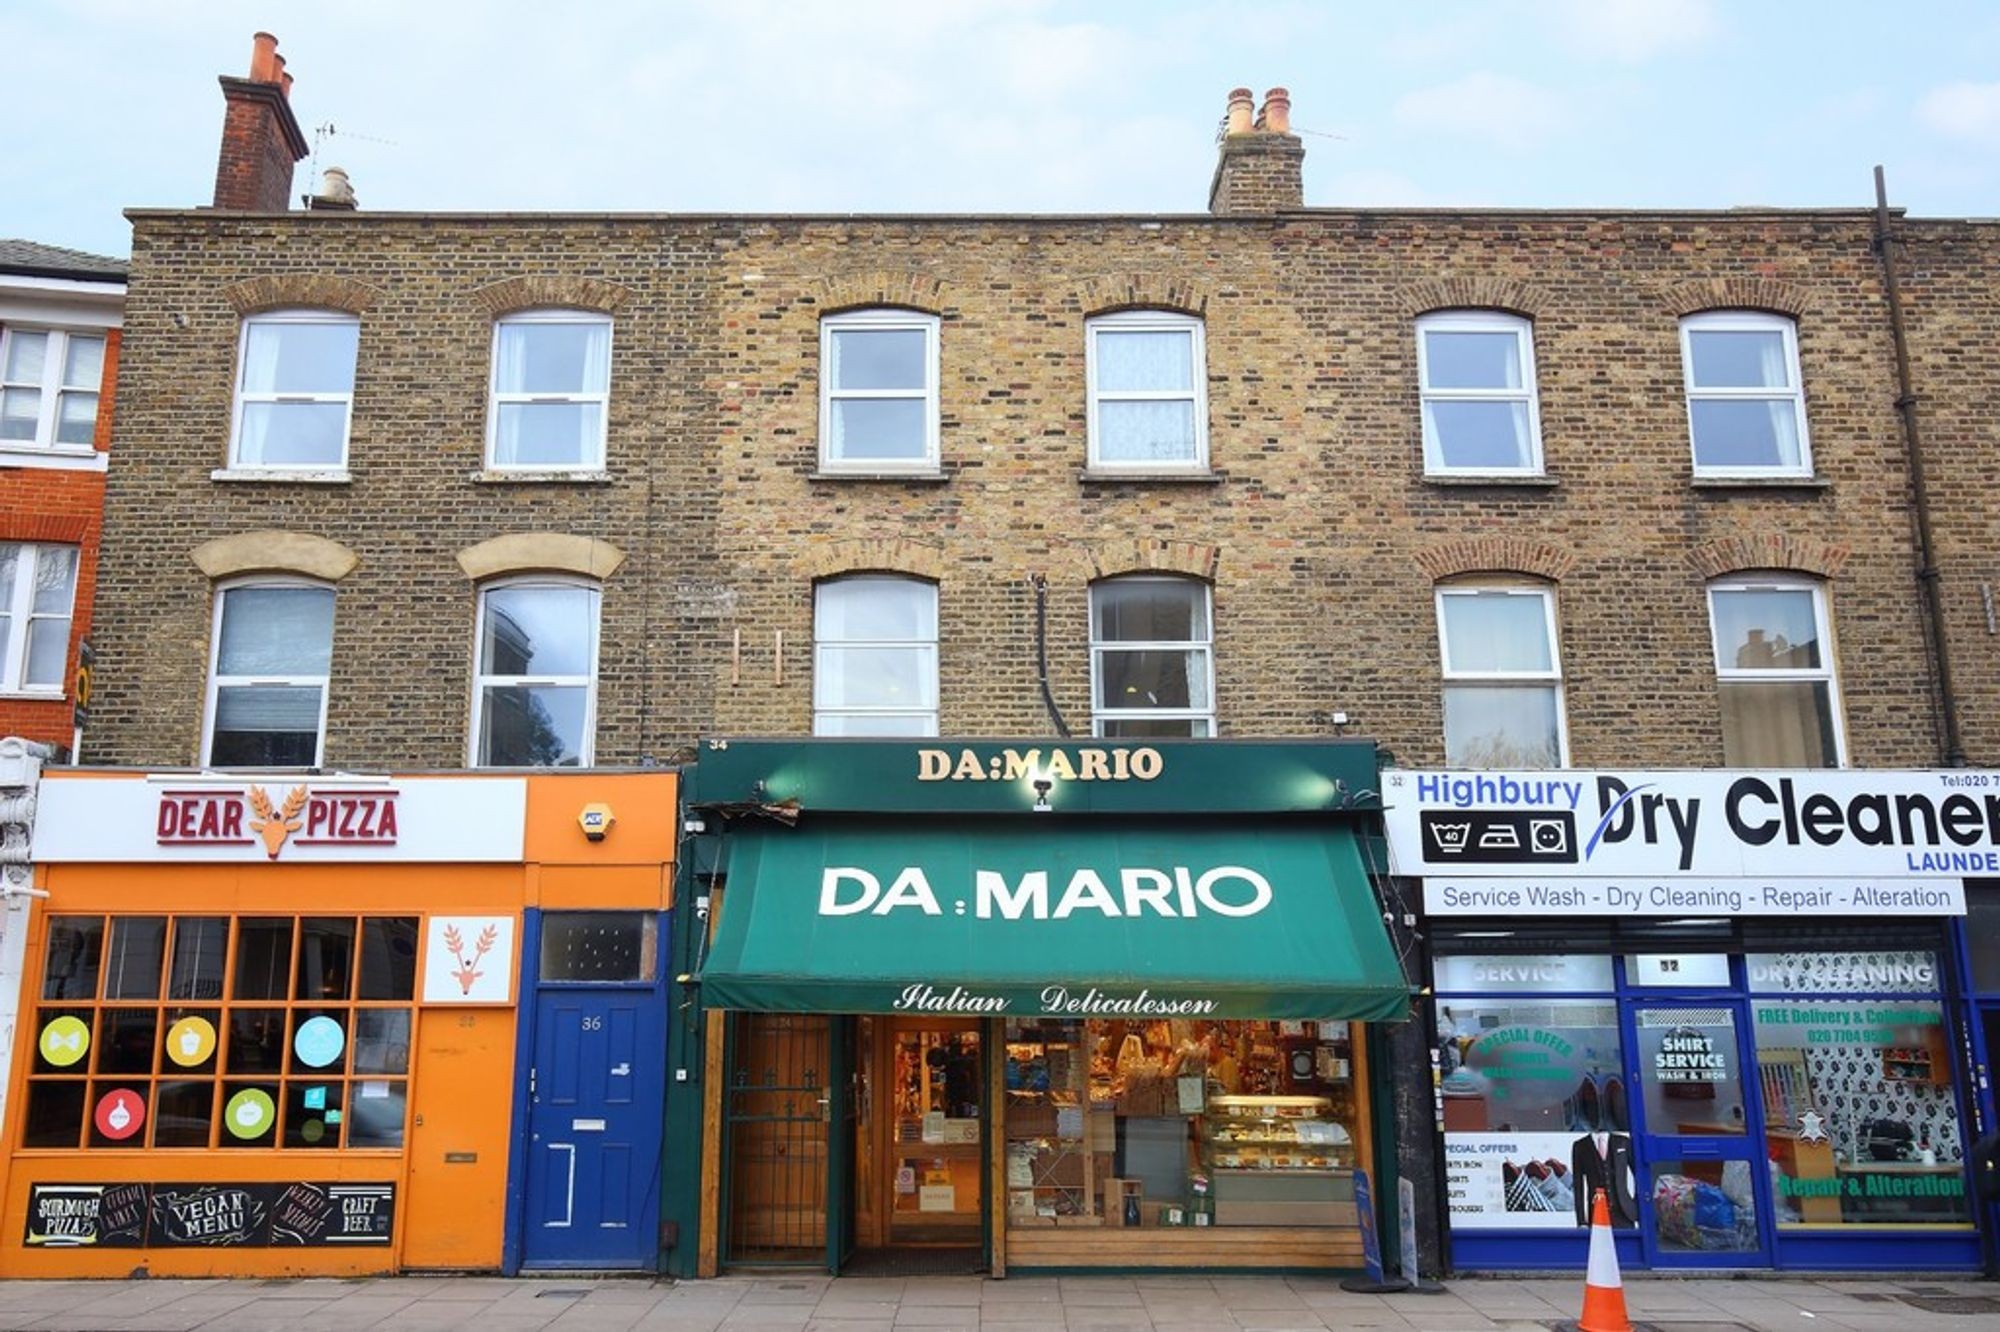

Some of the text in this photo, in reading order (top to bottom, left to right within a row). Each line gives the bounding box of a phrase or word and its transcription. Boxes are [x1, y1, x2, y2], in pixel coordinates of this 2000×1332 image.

[709, 740, 728, 750] 34
[1417, 775, 1582, 809] Highbury
[157, 800, 397, 837] DEAR PIZZA
[1596, 776, 1700, 870] Dry
[1445, 832, 1458, 841] 40
[1443, 886, 1521, 907] Service
[1527, 887, 1586, 907] Wash
[1607, 886, 1642, 911] Dry
[1650, 886, 1743, 911] Cleaning
[1763, 887, 1833, 911] Repair
[1853, 887, 1951, 907] Alteration
[1474, 965, 1566, 981] SERVICE
[1752, 965, 1933, 982] DRY CLEANING
[893, 983, 1220, 1014] Italian Delicatessen
[582, 1016, 601, 1030] 36
[1757, 1009, 1788, 1024] FREE
[1792, 1009, 1850, 1025] Delivery
[1662, 1037, 1713, 1052] SHIRT
[1656, 1053, 1725, 1068] SERVICE
[1657, 1071, 1687, 1080] WASH
[1479, 1144, 1518, 1154] OFFERS
[1777, 1174, 1964, 1197] Repair & Alteration
[172, 1193, 242, 1221] VEGAN
[342, 1197, 378, 1214] CRAFT
[185, 1212, 243, 1237] MENU
